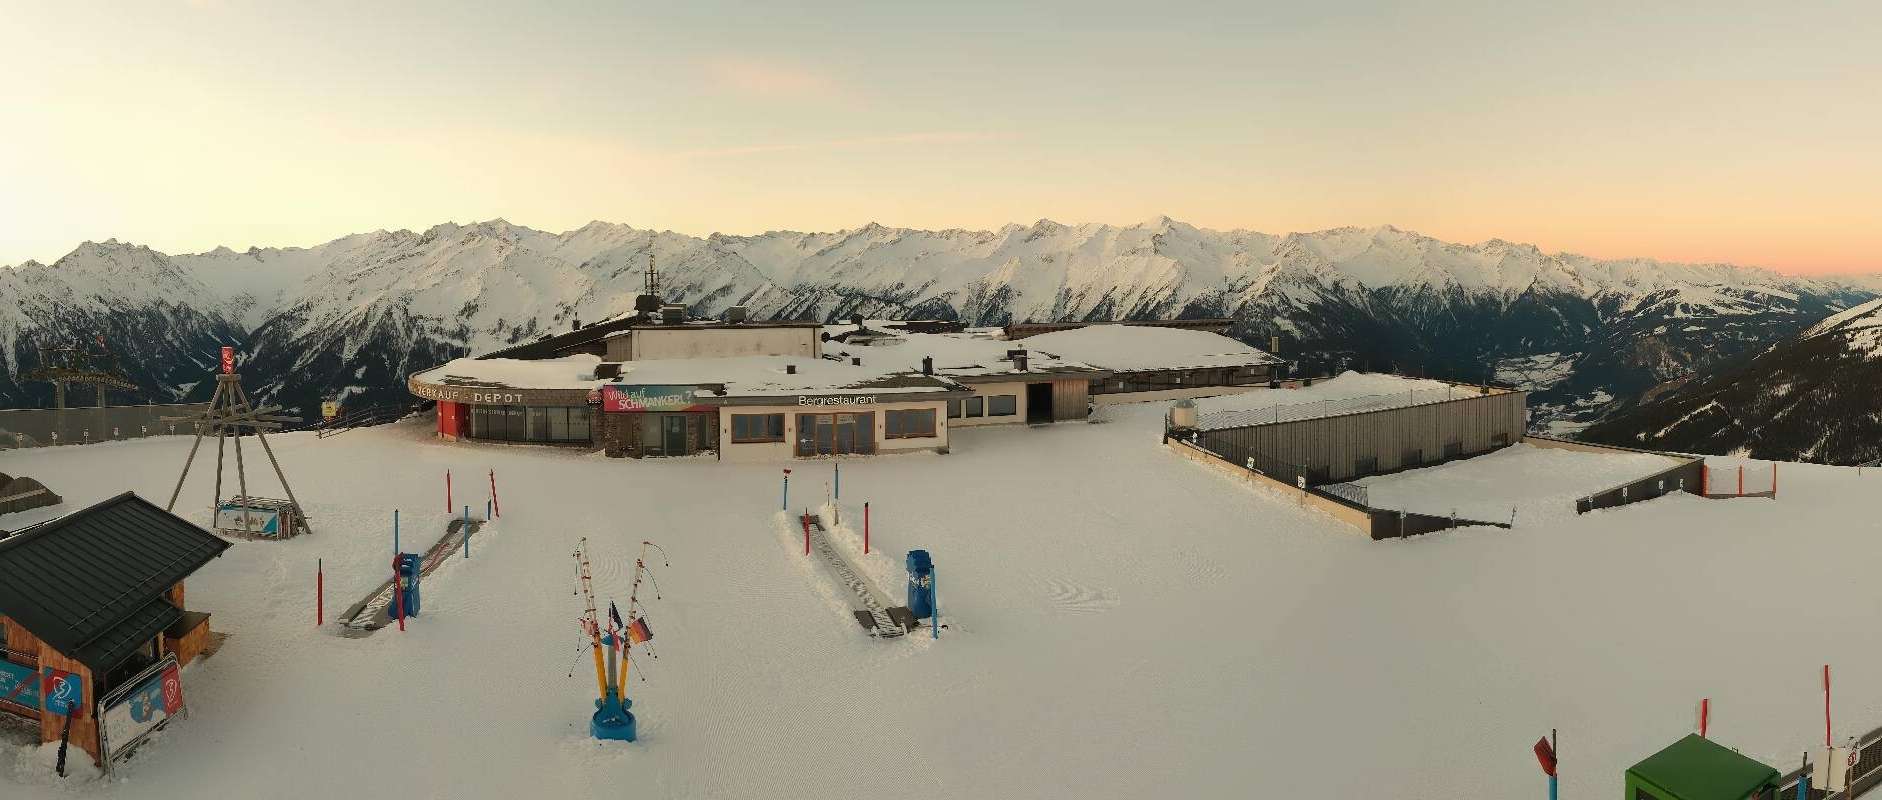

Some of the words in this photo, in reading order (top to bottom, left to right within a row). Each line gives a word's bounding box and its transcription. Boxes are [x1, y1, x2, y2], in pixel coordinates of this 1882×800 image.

[418, 386, 459, 399] VERKAUF
[474, 393, 523, 403] DEPOT
[609, 391, 629, 400] Wild
[631, 388, 646, 397] auf
[798, 394, 877, 408] Bergrestaurant
